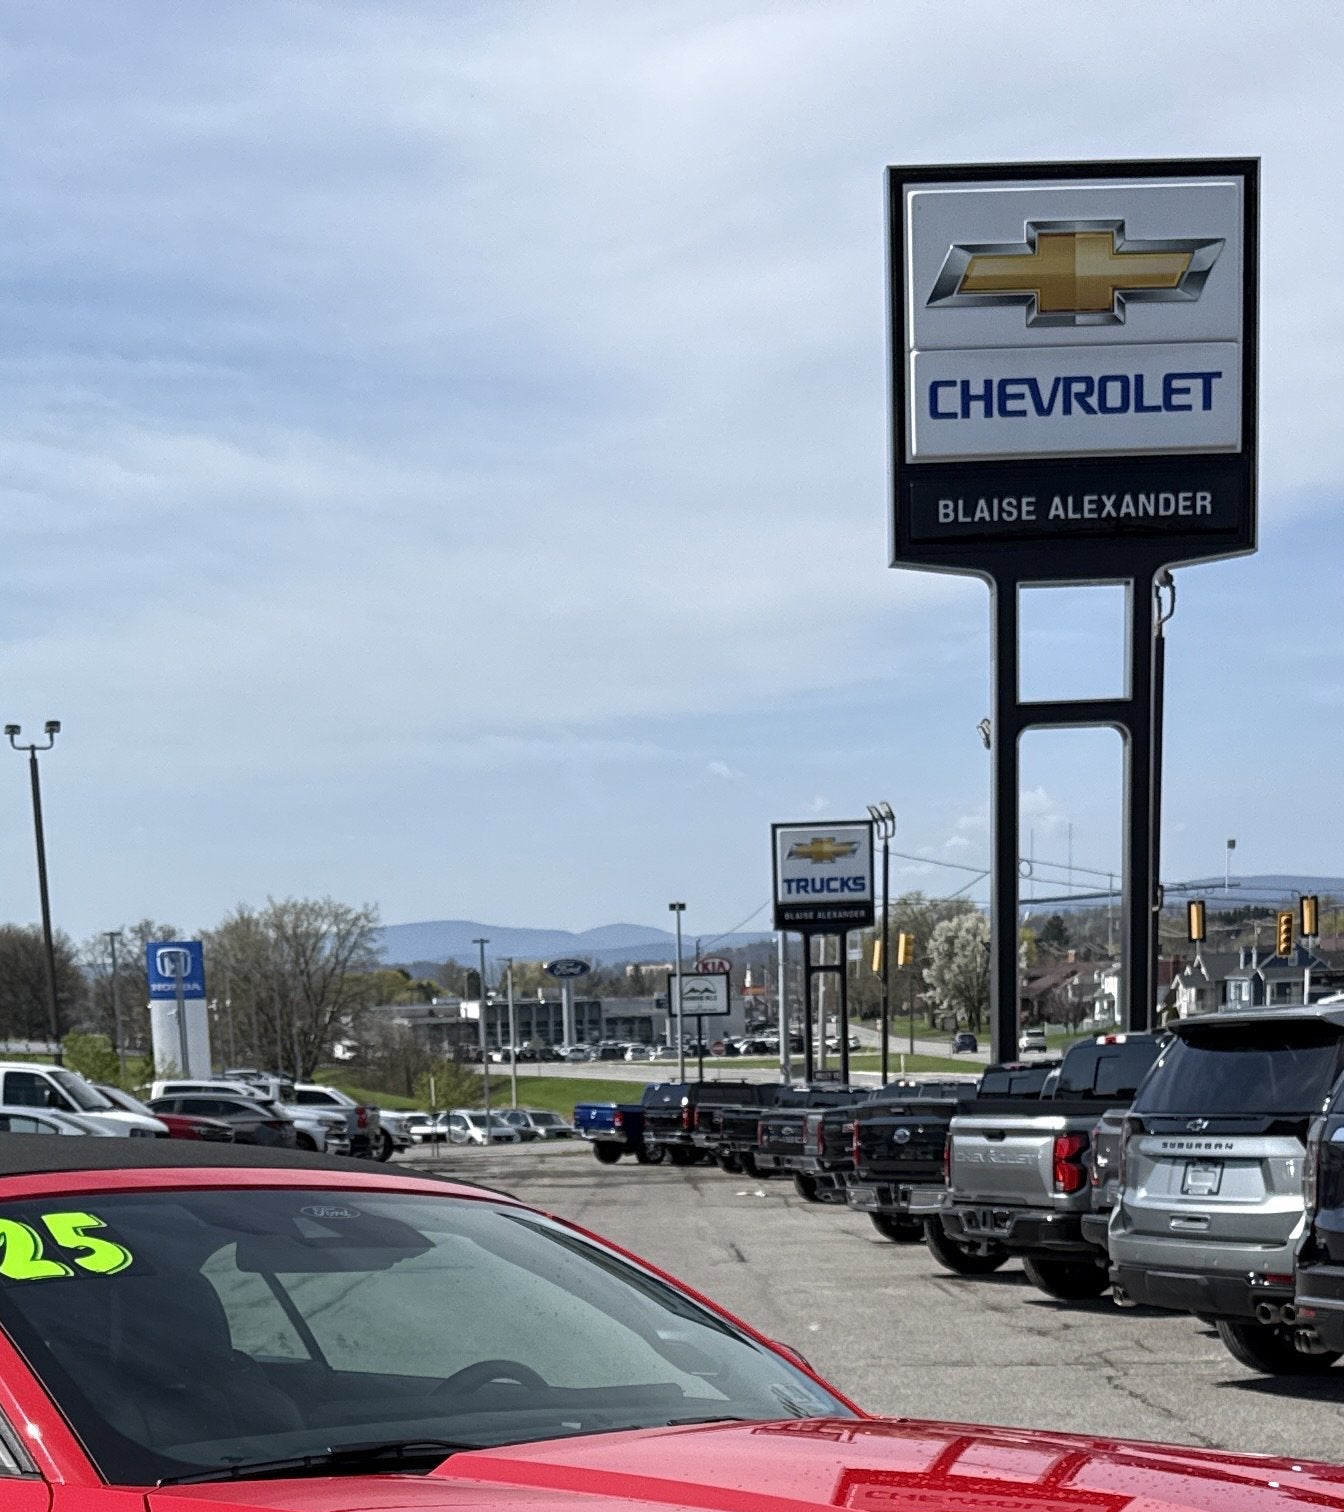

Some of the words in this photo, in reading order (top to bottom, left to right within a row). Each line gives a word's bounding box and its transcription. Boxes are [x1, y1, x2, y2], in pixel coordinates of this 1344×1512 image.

[928, 371, 1223, 420] CHEVROLET
[937, 497, 1037, 524] BLAISE
[1048, 492, 1212, 520] ALEXANDER
[783, 876, 866, 894] TRUCKS
[784, 911, 815, 920] BLAISE
[816, 910, 866, 919] ALEXANDER
[702, 961, 727, 973] KIA
[1162, 1142, 1234, 1150] SUBURBAN
[312, 1207, 352, 1217] Ford
